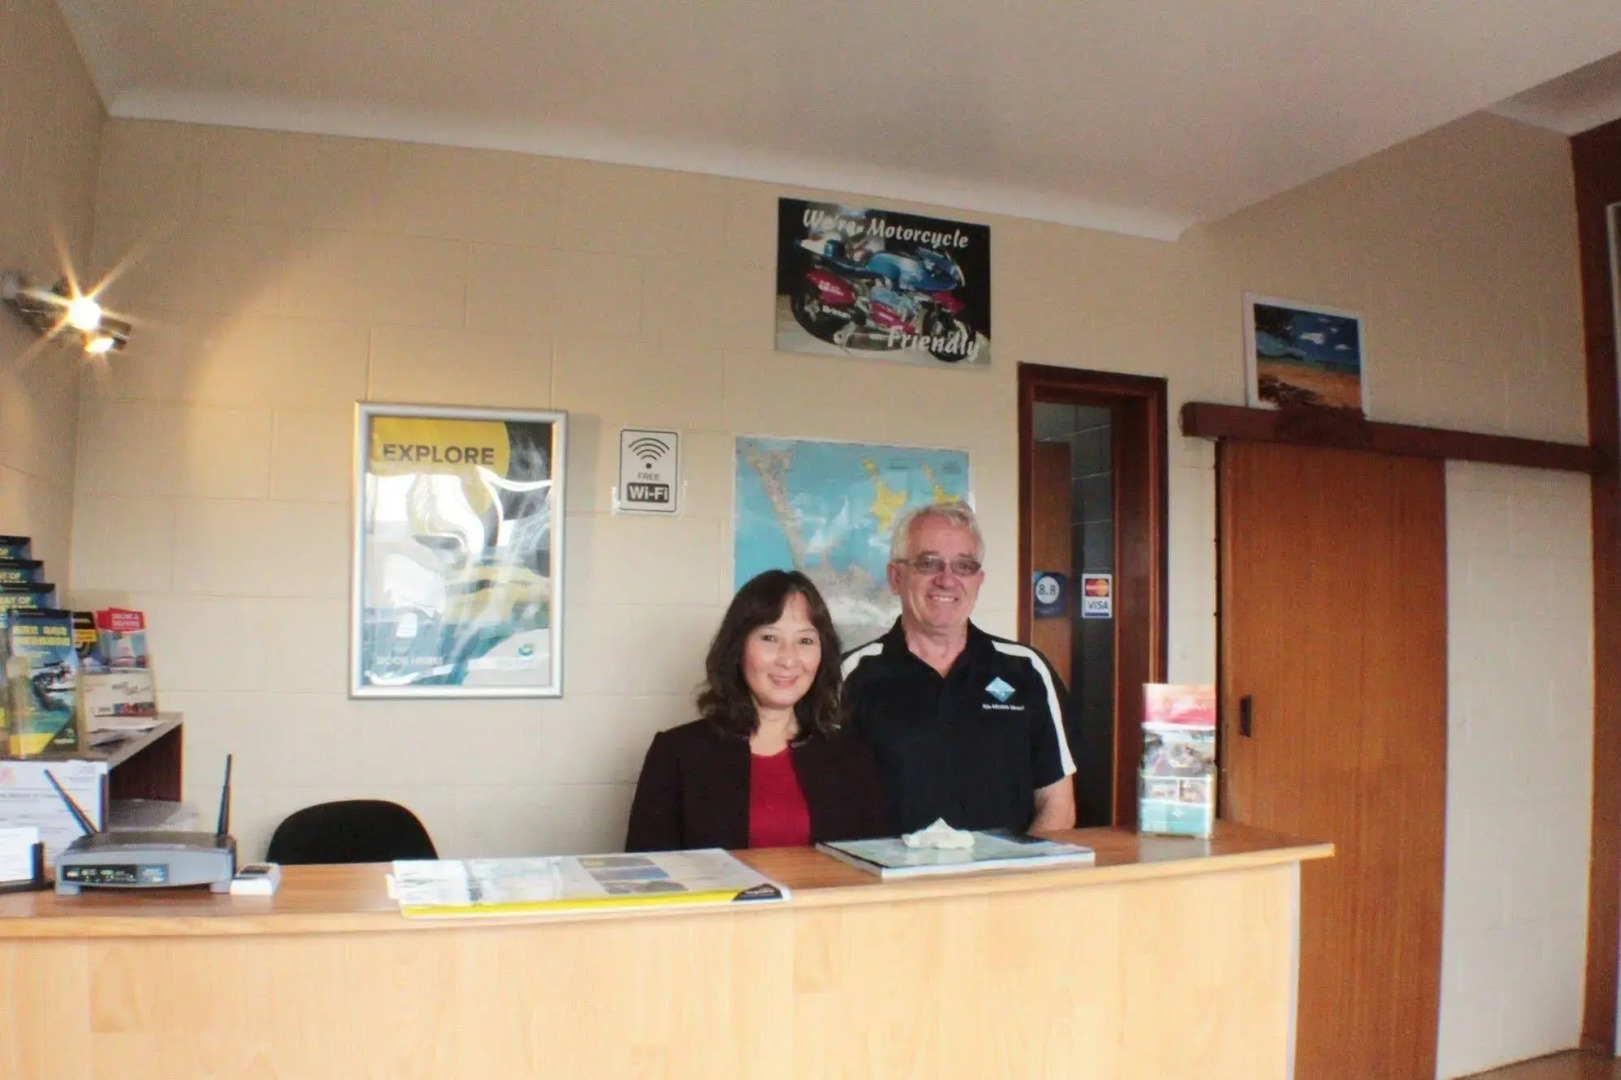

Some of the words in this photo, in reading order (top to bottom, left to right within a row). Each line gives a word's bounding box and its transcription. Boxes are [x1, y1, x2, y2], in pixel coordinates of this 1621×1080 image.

[867, 219, 969, 248] Motorcycle
[887, 330, 980, 361] Friendly
[383, 444, 494, 465] EXPLORE
[637, 472, 660, 480] FREE
[629, 486, 668, 500] Wi-Fi
[1039, 585, 1056, 595] 8.8
[1088, 601, 1109, 610] VISA
